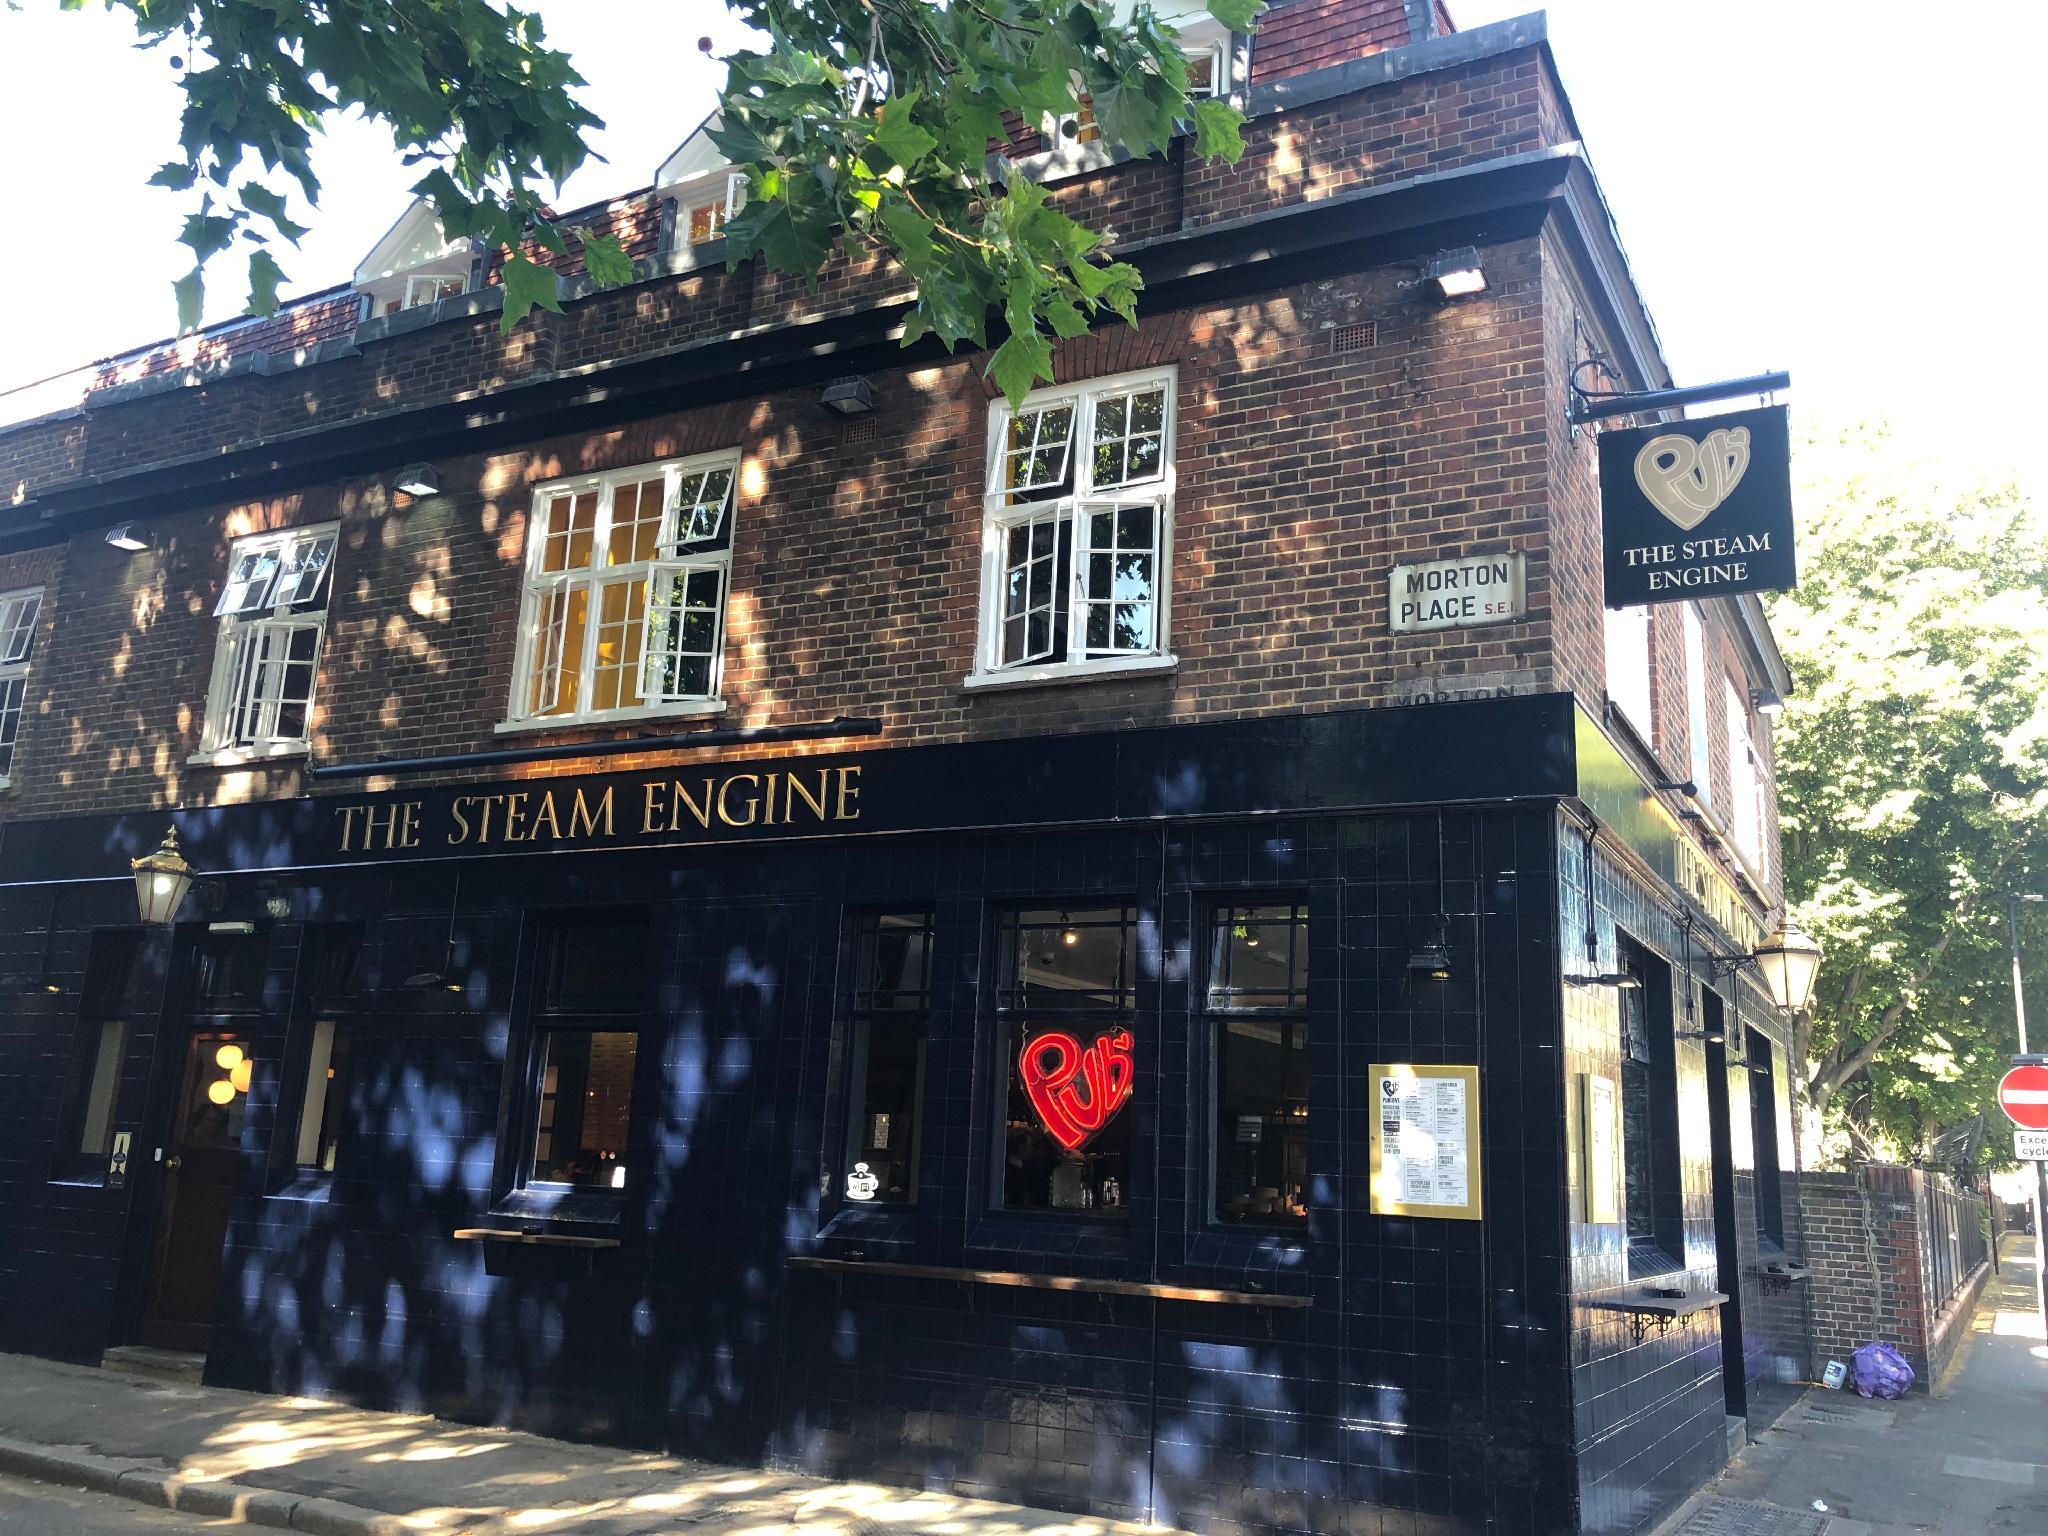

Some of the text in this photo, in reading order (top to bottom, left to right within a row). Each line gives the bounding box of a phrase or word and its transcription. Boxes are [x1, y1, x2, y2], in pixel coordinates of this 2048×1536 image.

[1623, 532, 1772, 567] THE STEAM
[1406, 562, 1508, 594] MORTON
[1648, 563, 1749, 590] ENGINE
[1401, 595, 1476, 624] PLACE
[334, 765, 862, 852] THE STEAM ENGINE
[2020, 1135, 2047, 1145] Exce
